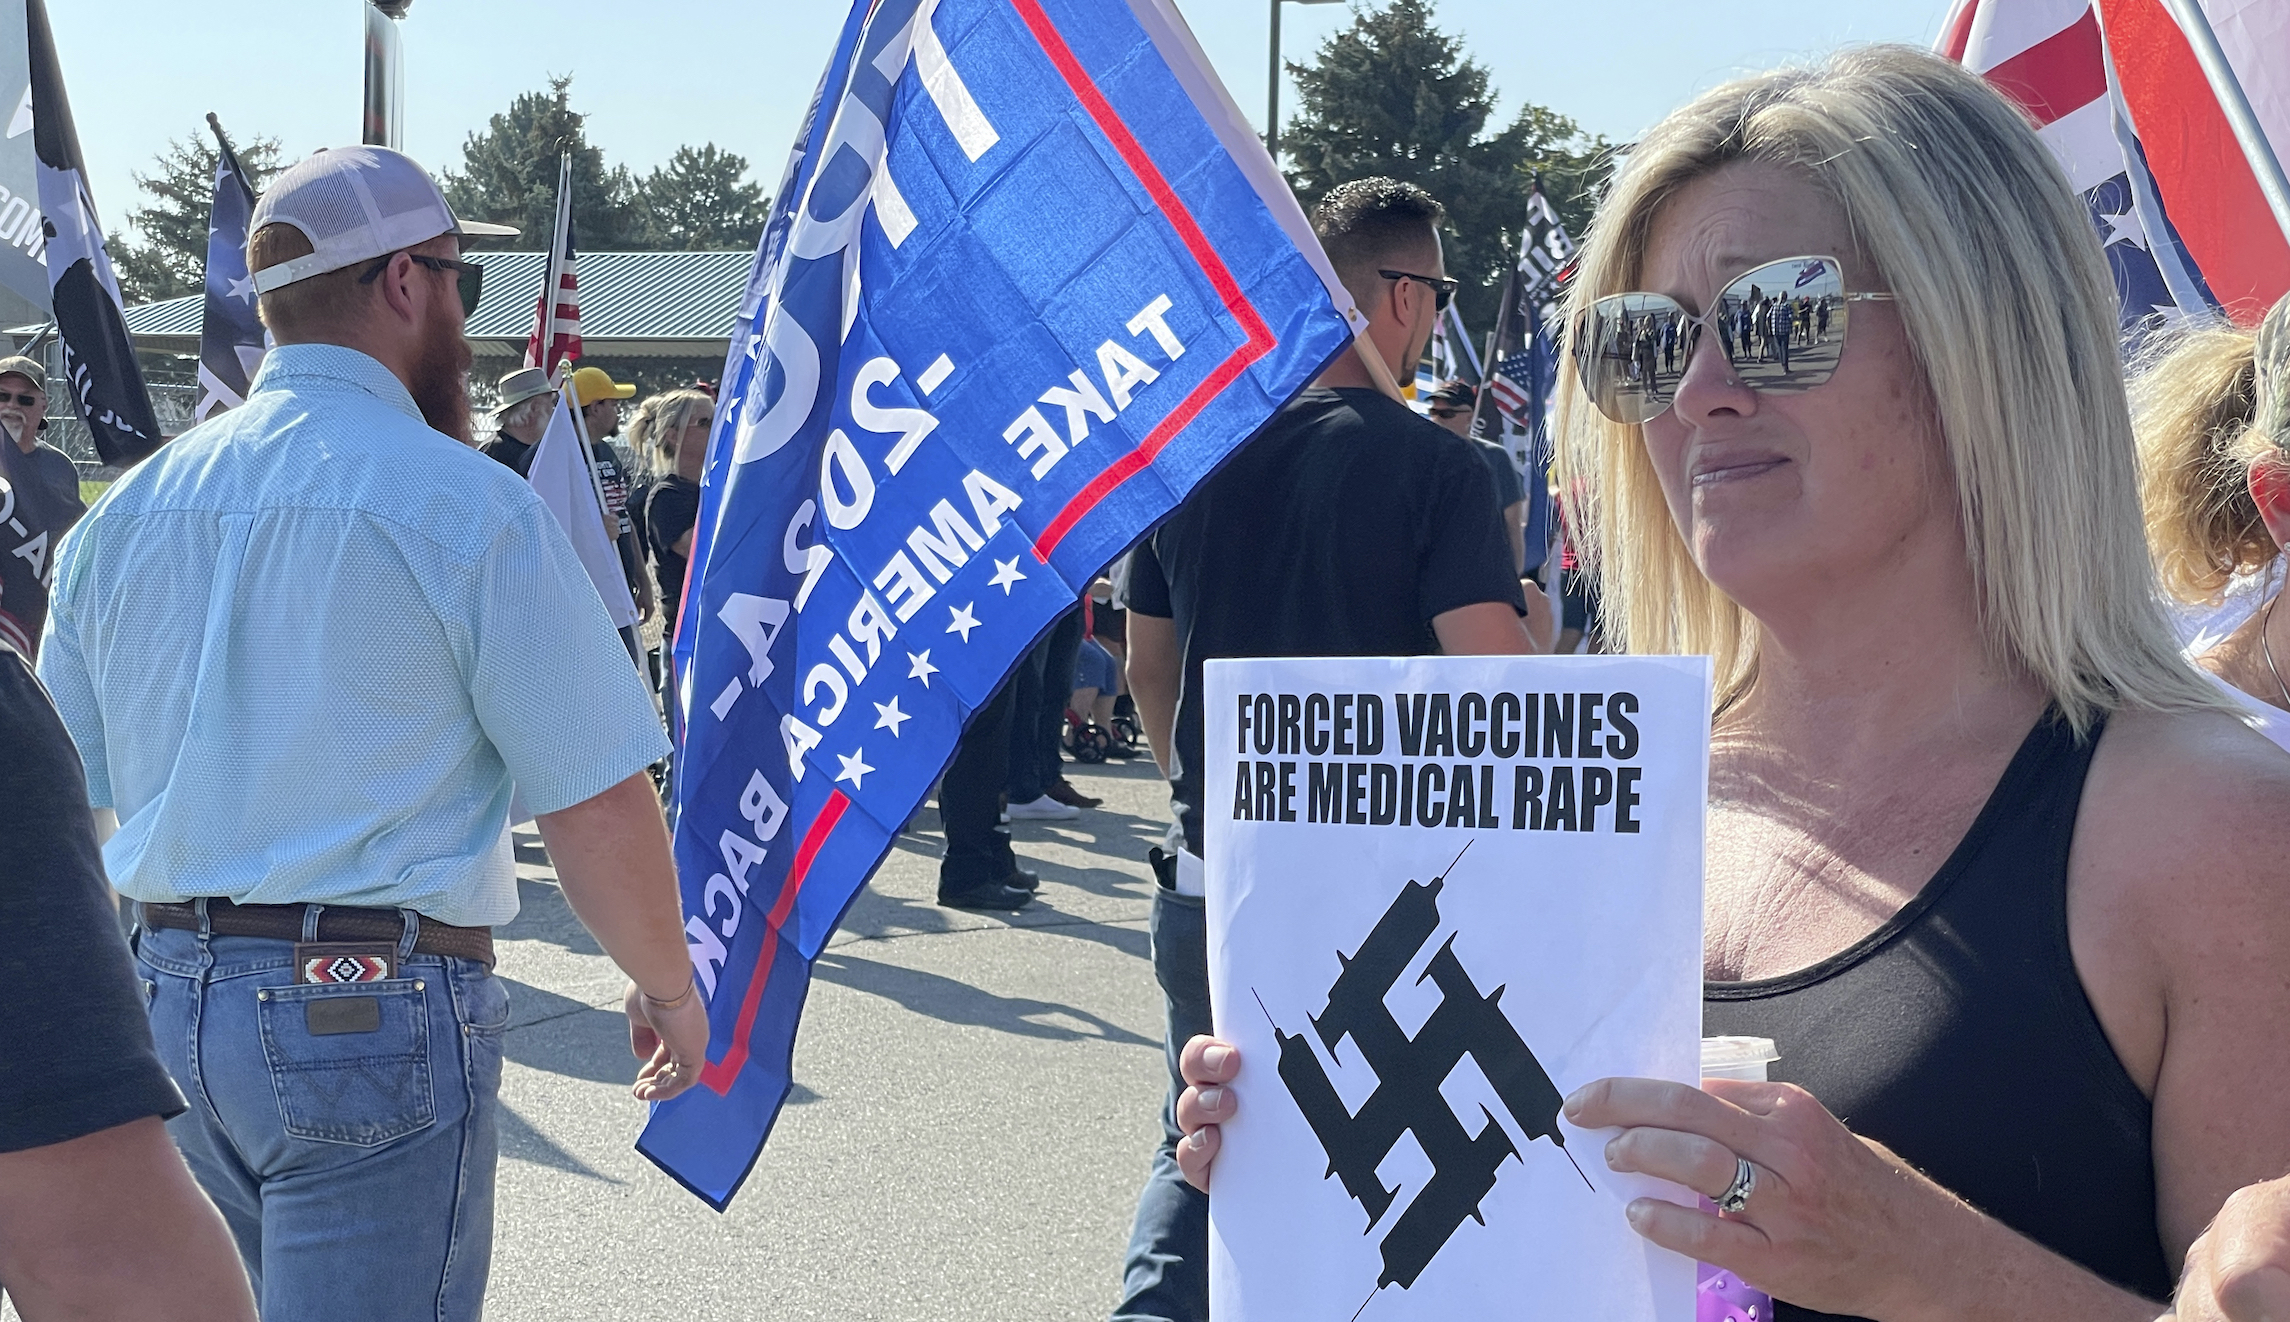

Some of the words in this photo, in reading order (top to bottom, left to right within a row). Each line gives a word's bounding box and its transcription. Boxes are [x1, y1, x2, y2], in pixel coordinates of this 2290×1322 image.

[1238, 693, 1383, 756] FORCED
[1395, 692, 1640, 760] VACCINES
[1233, 761, 1297, 824] ARE
[1307, 762, 1499, 829] MEDICAL
[1512, 766, 1642, 833] RAPE
